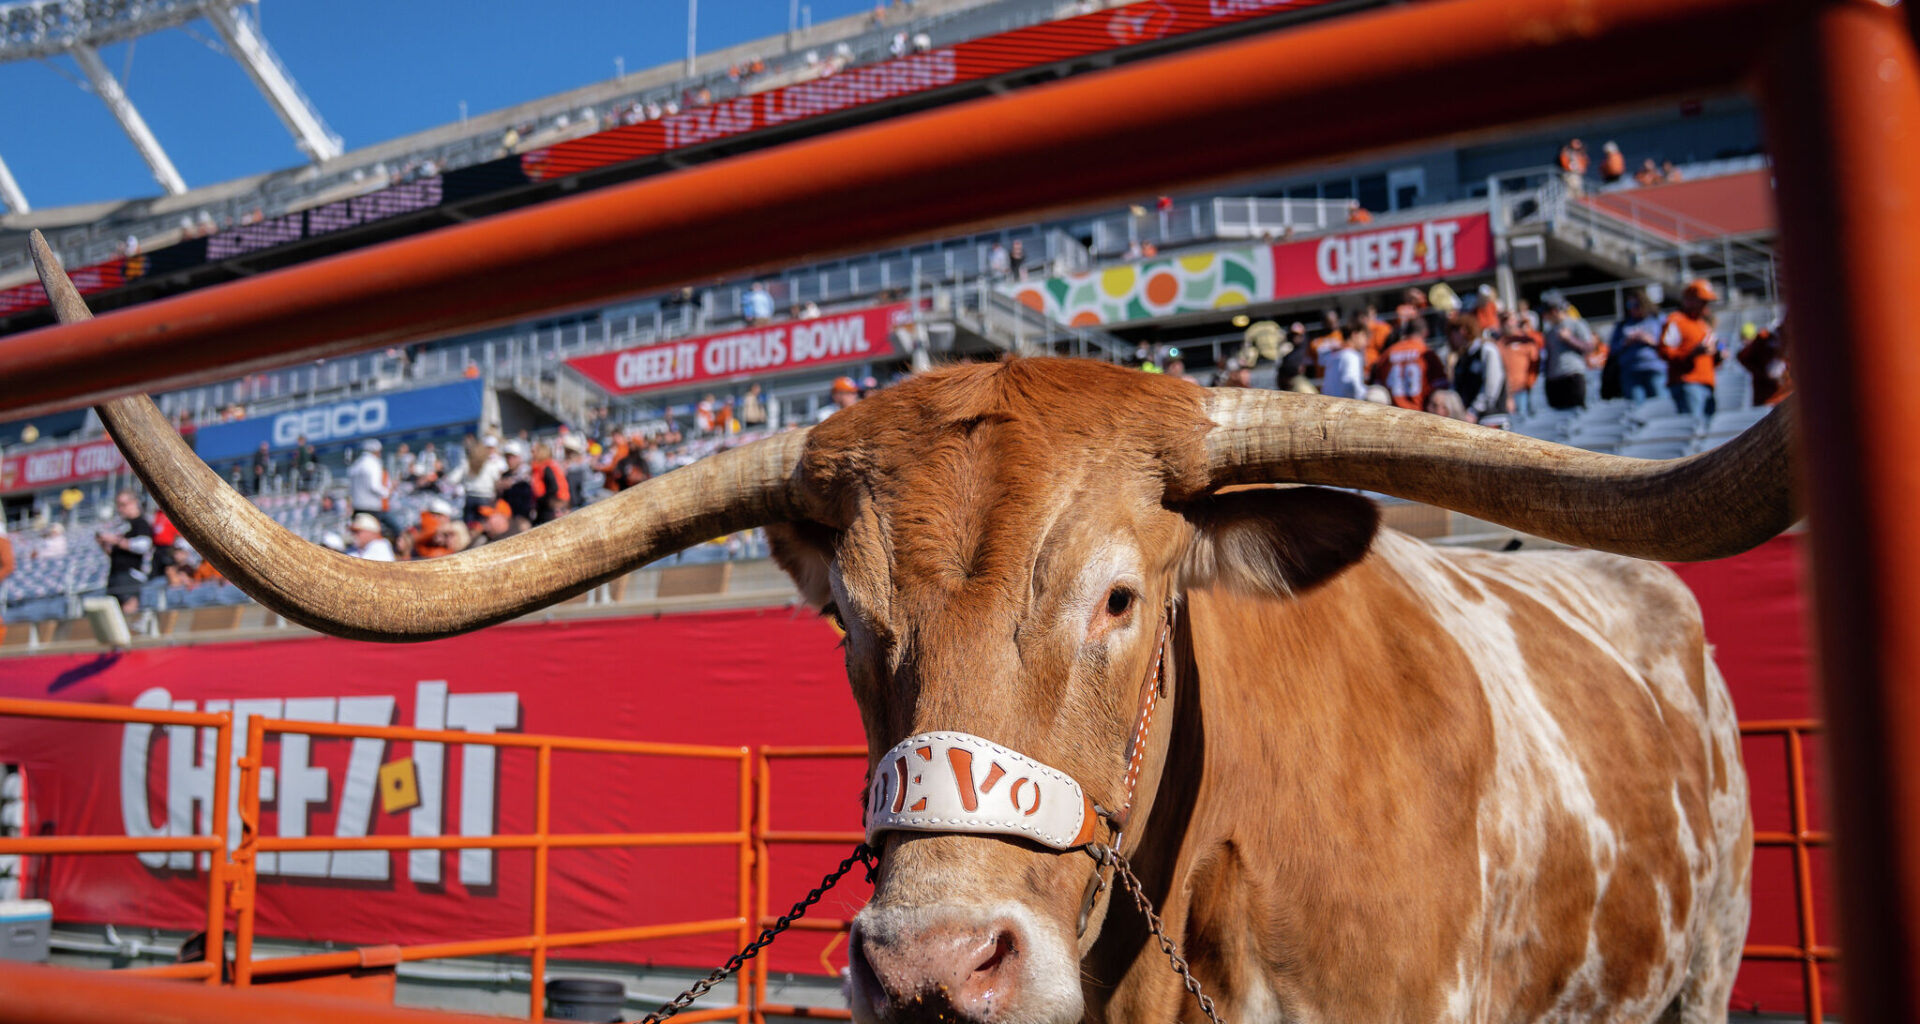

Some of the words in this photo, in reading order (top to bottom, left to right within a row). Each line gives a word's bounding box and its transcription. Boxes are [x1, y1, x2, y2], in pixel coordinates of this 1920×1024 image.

[663, 97, 753, 149] TEXAS
[765, 50, 956, 126] LONGHORNS
[703, 327, 788, 375] CITRUS
[791, 315, 869, 362] BOWL
[273, 398, 388, 446] GEICO
